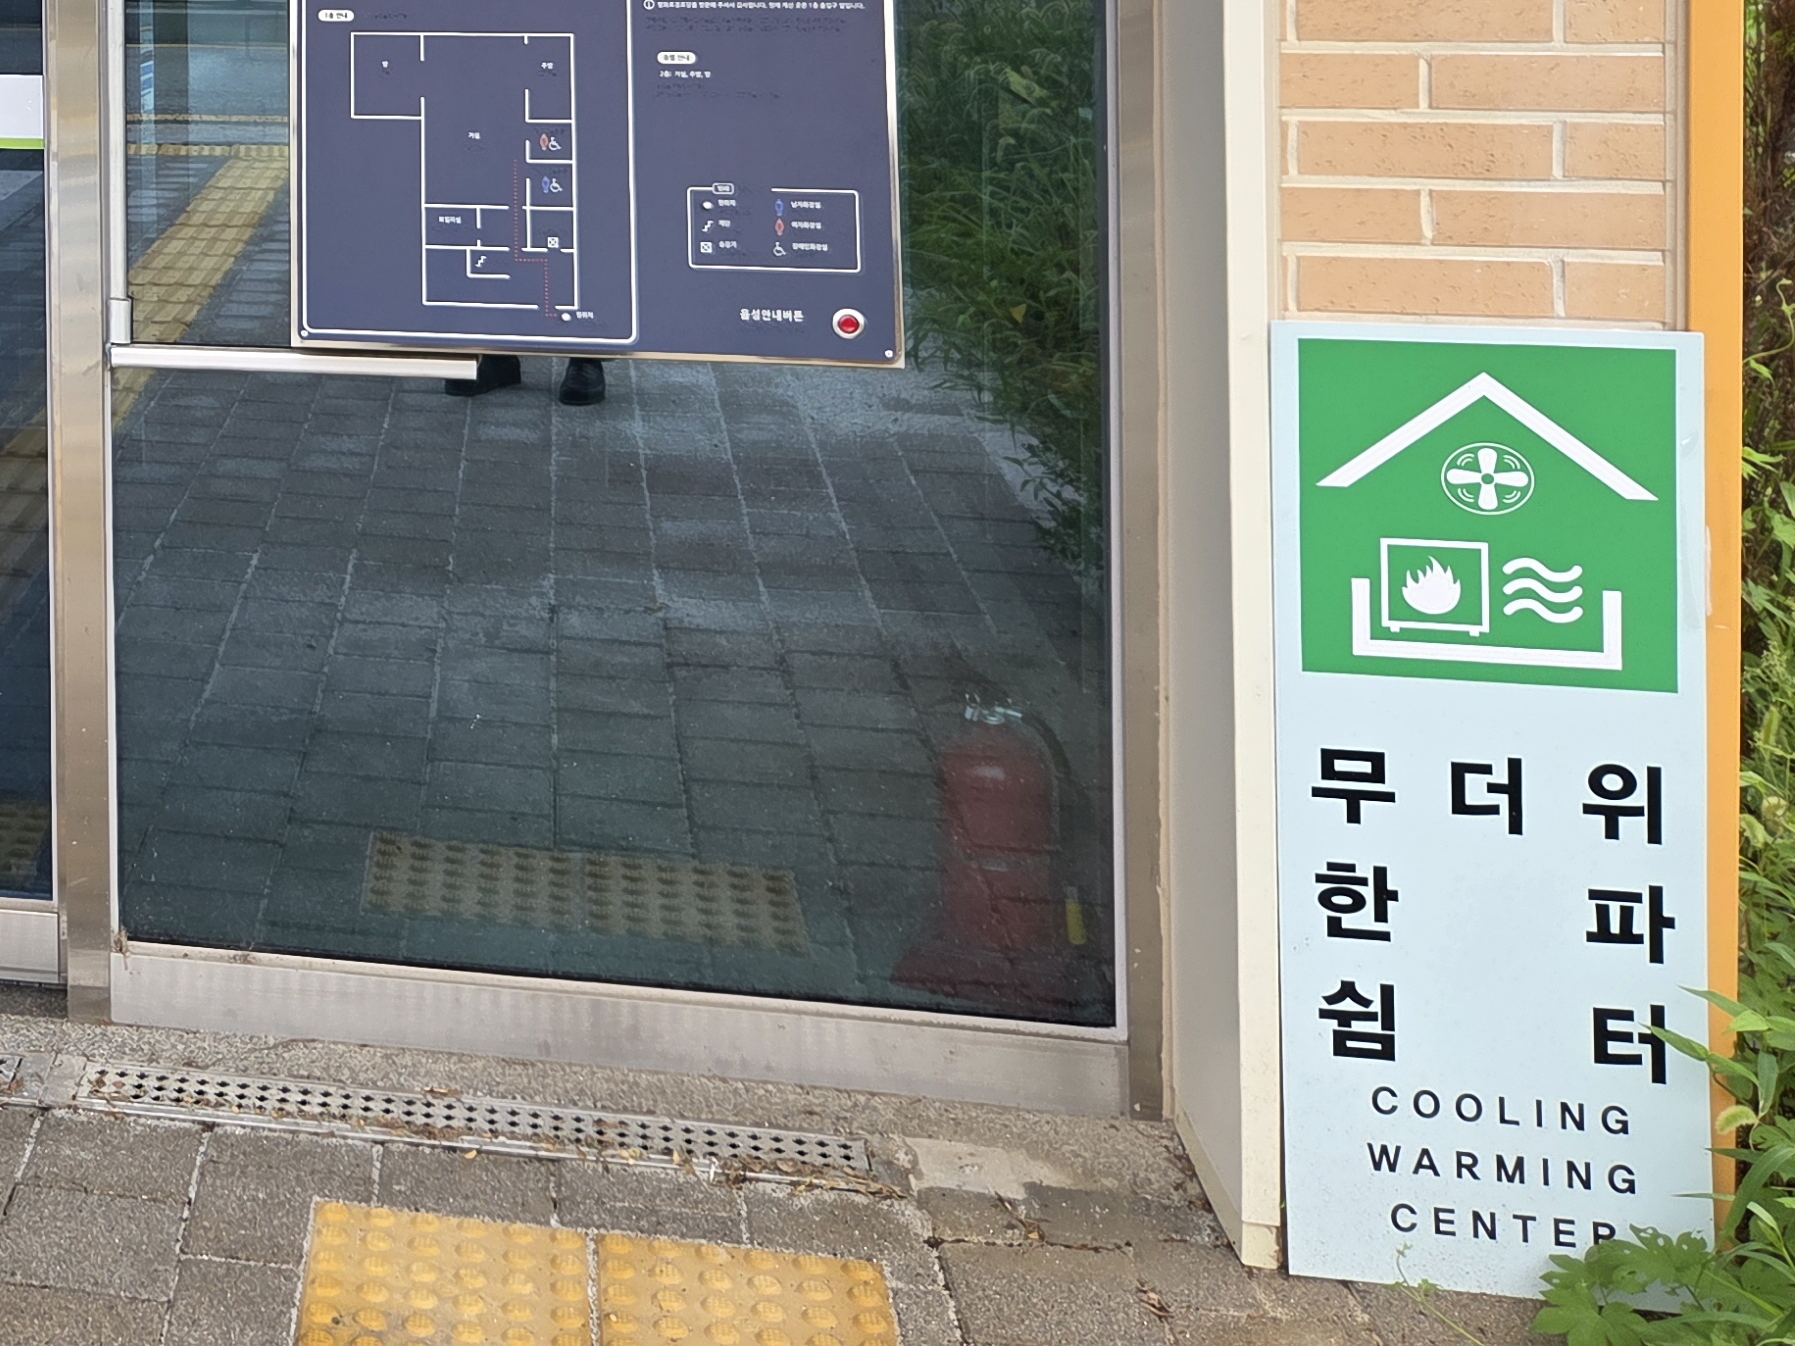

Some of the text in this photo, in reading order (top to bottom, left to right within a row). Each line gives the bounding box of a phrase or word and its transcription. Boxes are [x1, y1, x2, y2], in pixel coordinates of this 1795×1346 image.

[740, 308, 804, 322] 음성안내버튼
[1371, 1085, 1630, 1136] COOLING
[1367, 1142, 1637, 1194] WARMING
